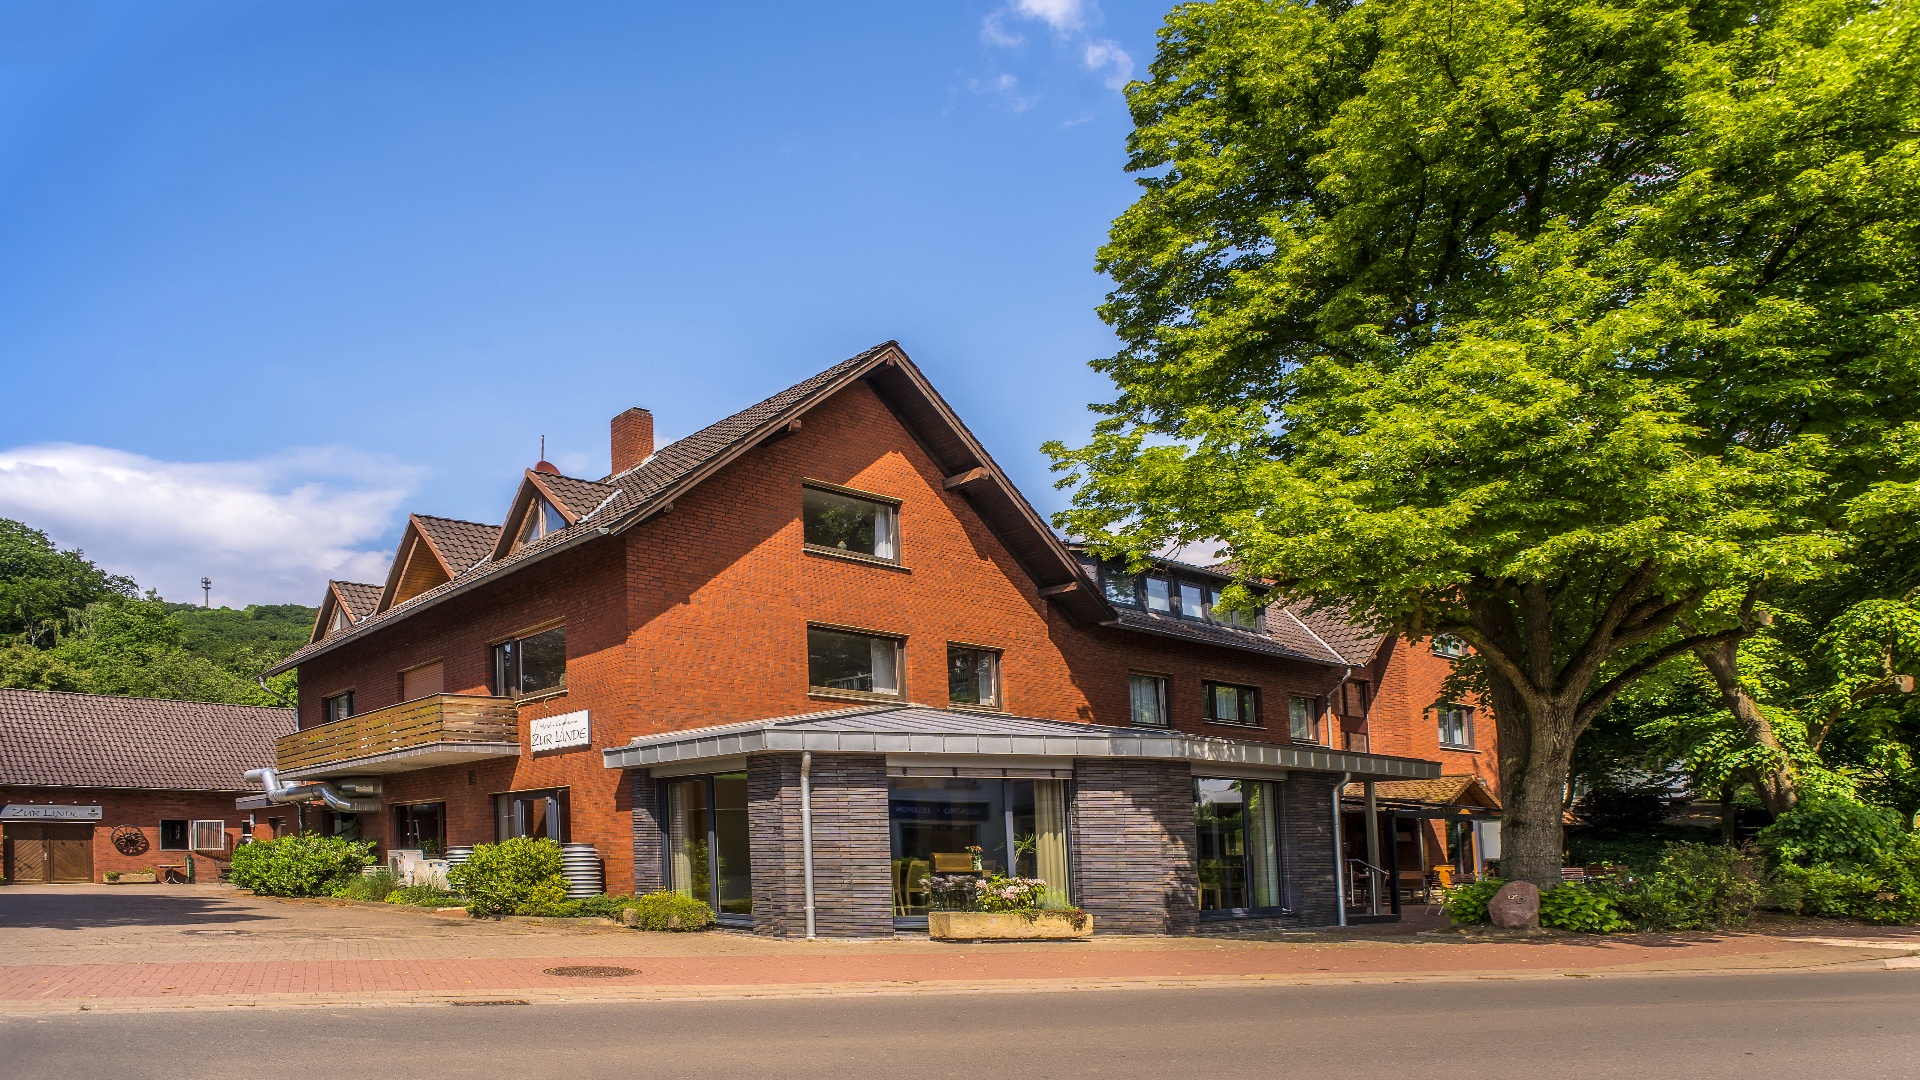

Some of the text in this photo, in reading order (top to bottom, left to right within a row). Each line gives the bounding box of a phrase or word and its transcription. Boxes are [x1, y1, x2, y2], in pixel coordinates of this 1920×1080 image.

[532, 728, 586, 746] ZUR LINDE
[12, 808, 40, 817] ZUR
